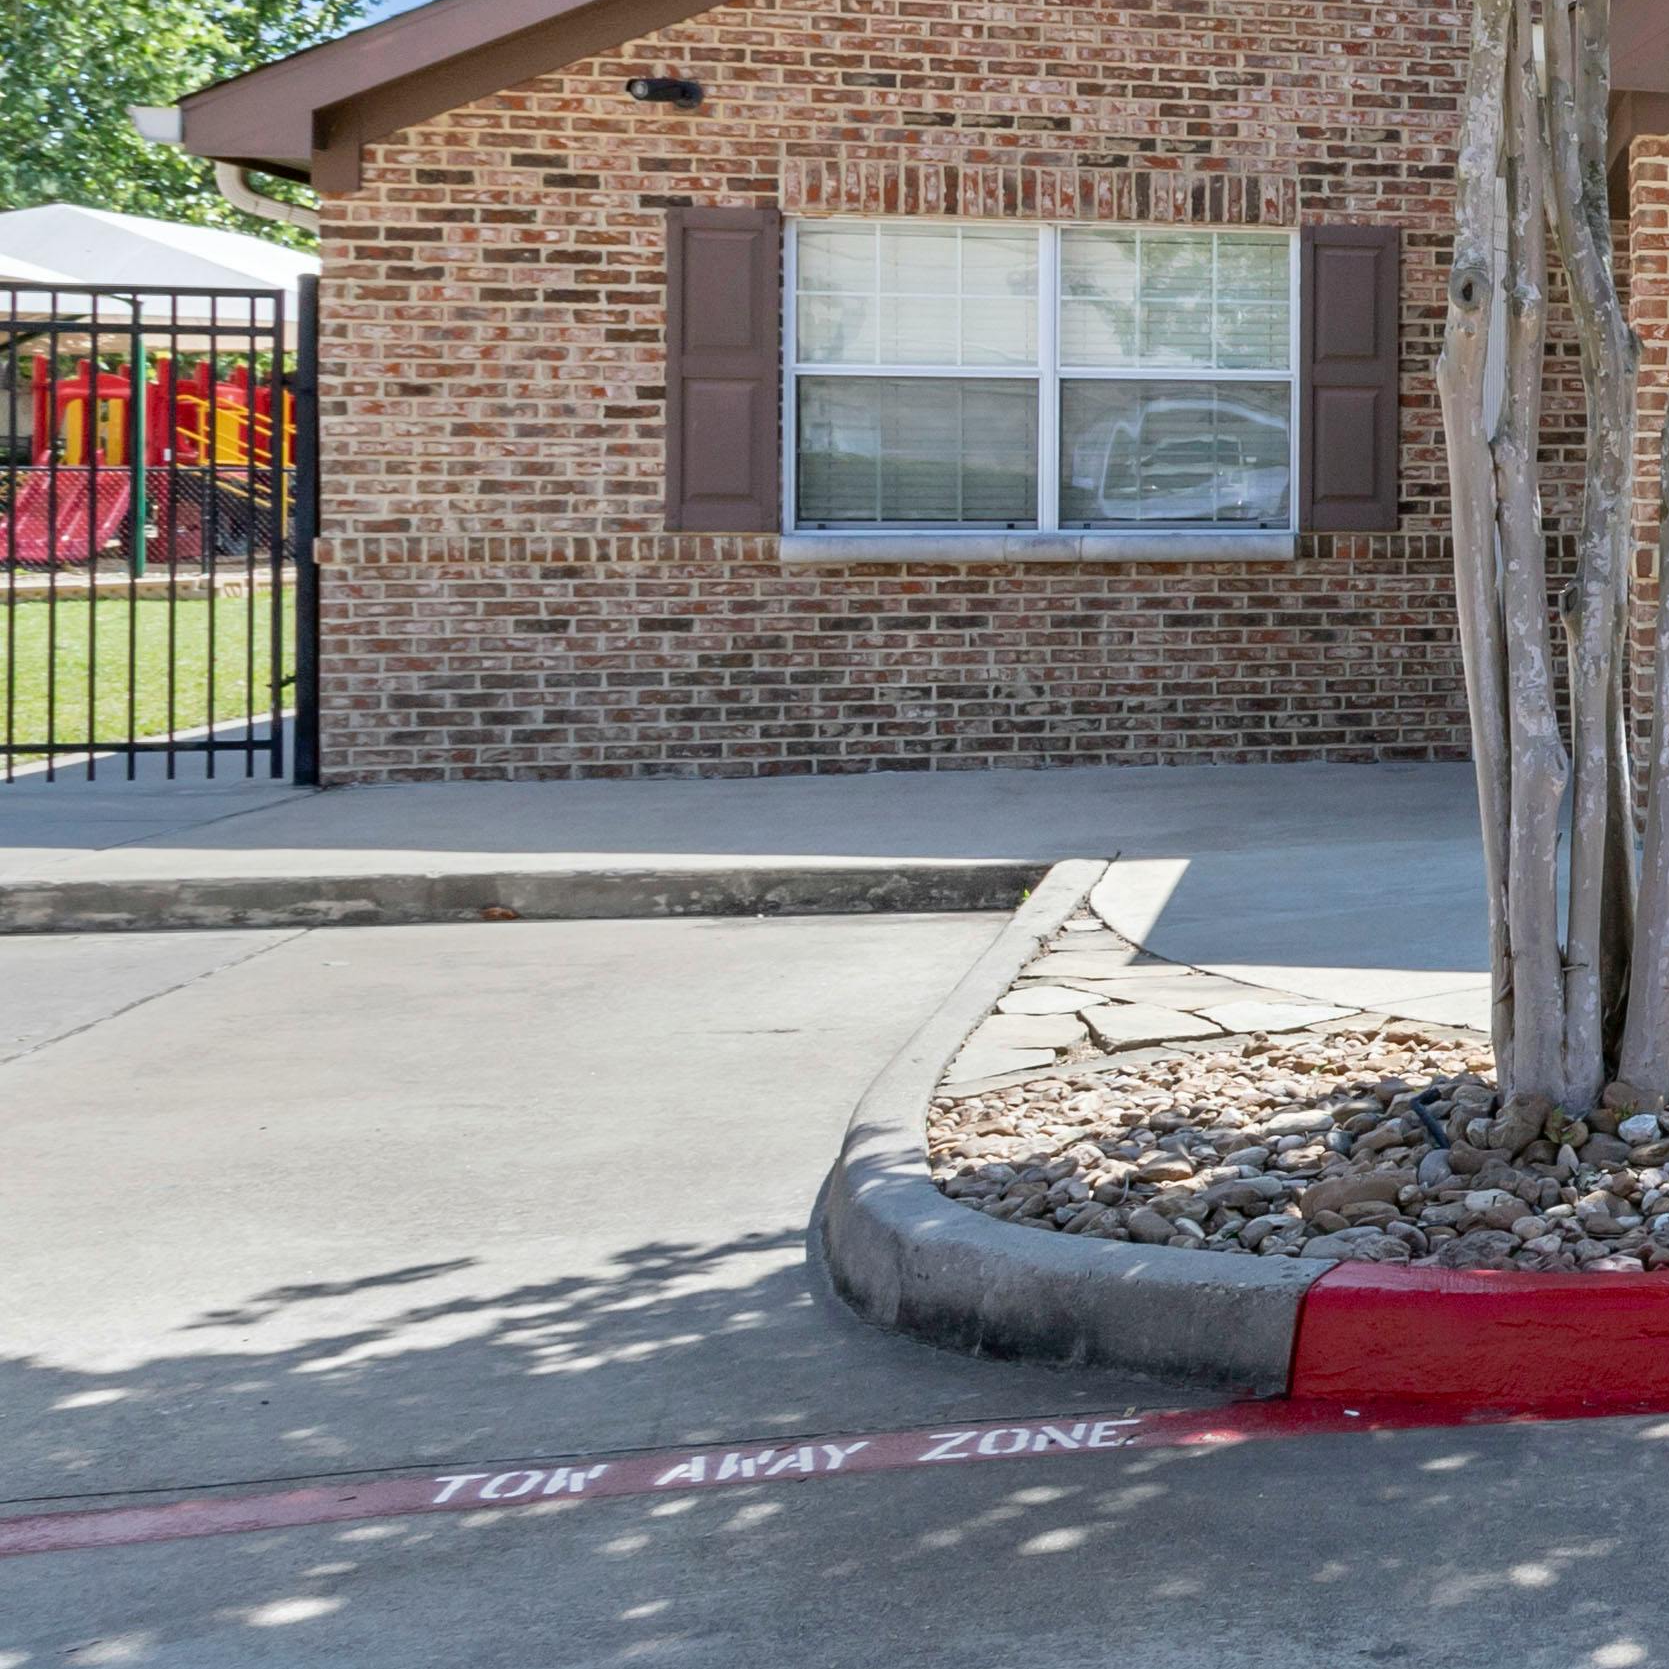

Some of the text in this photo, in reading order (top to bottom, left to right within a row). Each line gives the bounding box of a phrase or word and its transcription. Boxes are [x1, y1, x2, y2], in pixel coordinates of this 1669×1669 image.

[432, 1418, 1142, 1504] TOW AWAY ZONE
